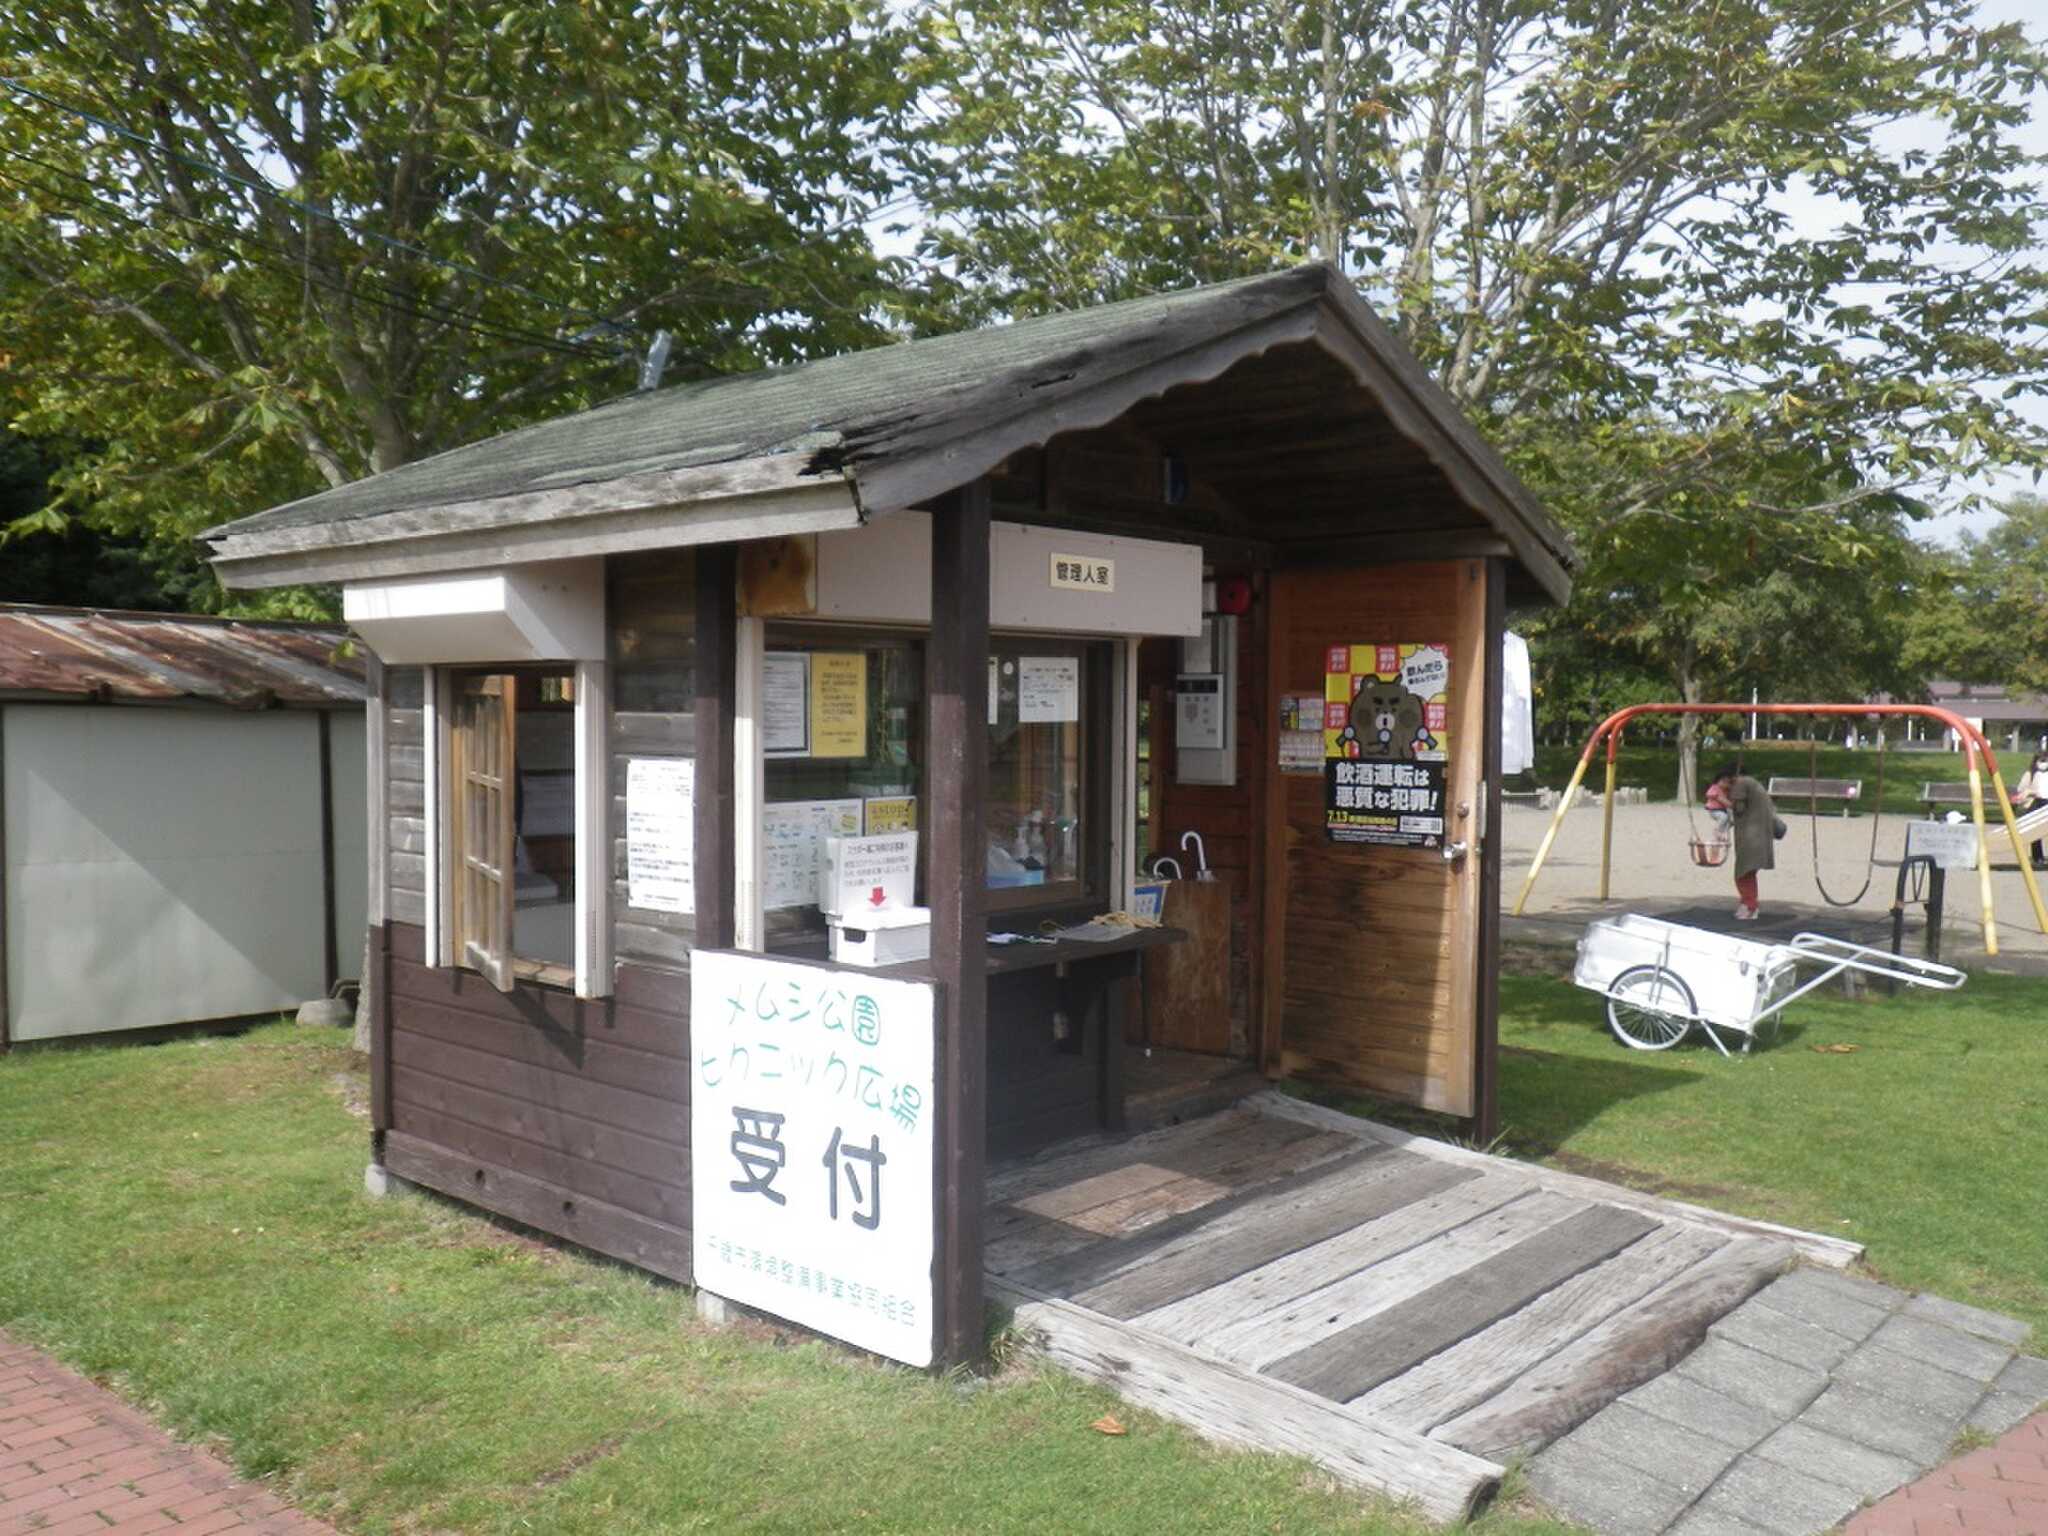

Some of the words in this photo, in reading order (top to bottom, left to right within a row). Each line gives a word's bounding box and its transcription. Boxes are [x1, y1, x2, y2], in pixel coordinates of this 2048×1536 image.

[1056, 560, 1109, 585] 管理人室
[1335, 762, 1430, 787] 飲酒運転は
[726, 981, 881, 1046] メムシ公園
[729, 1105, 888, 1231] 受付
